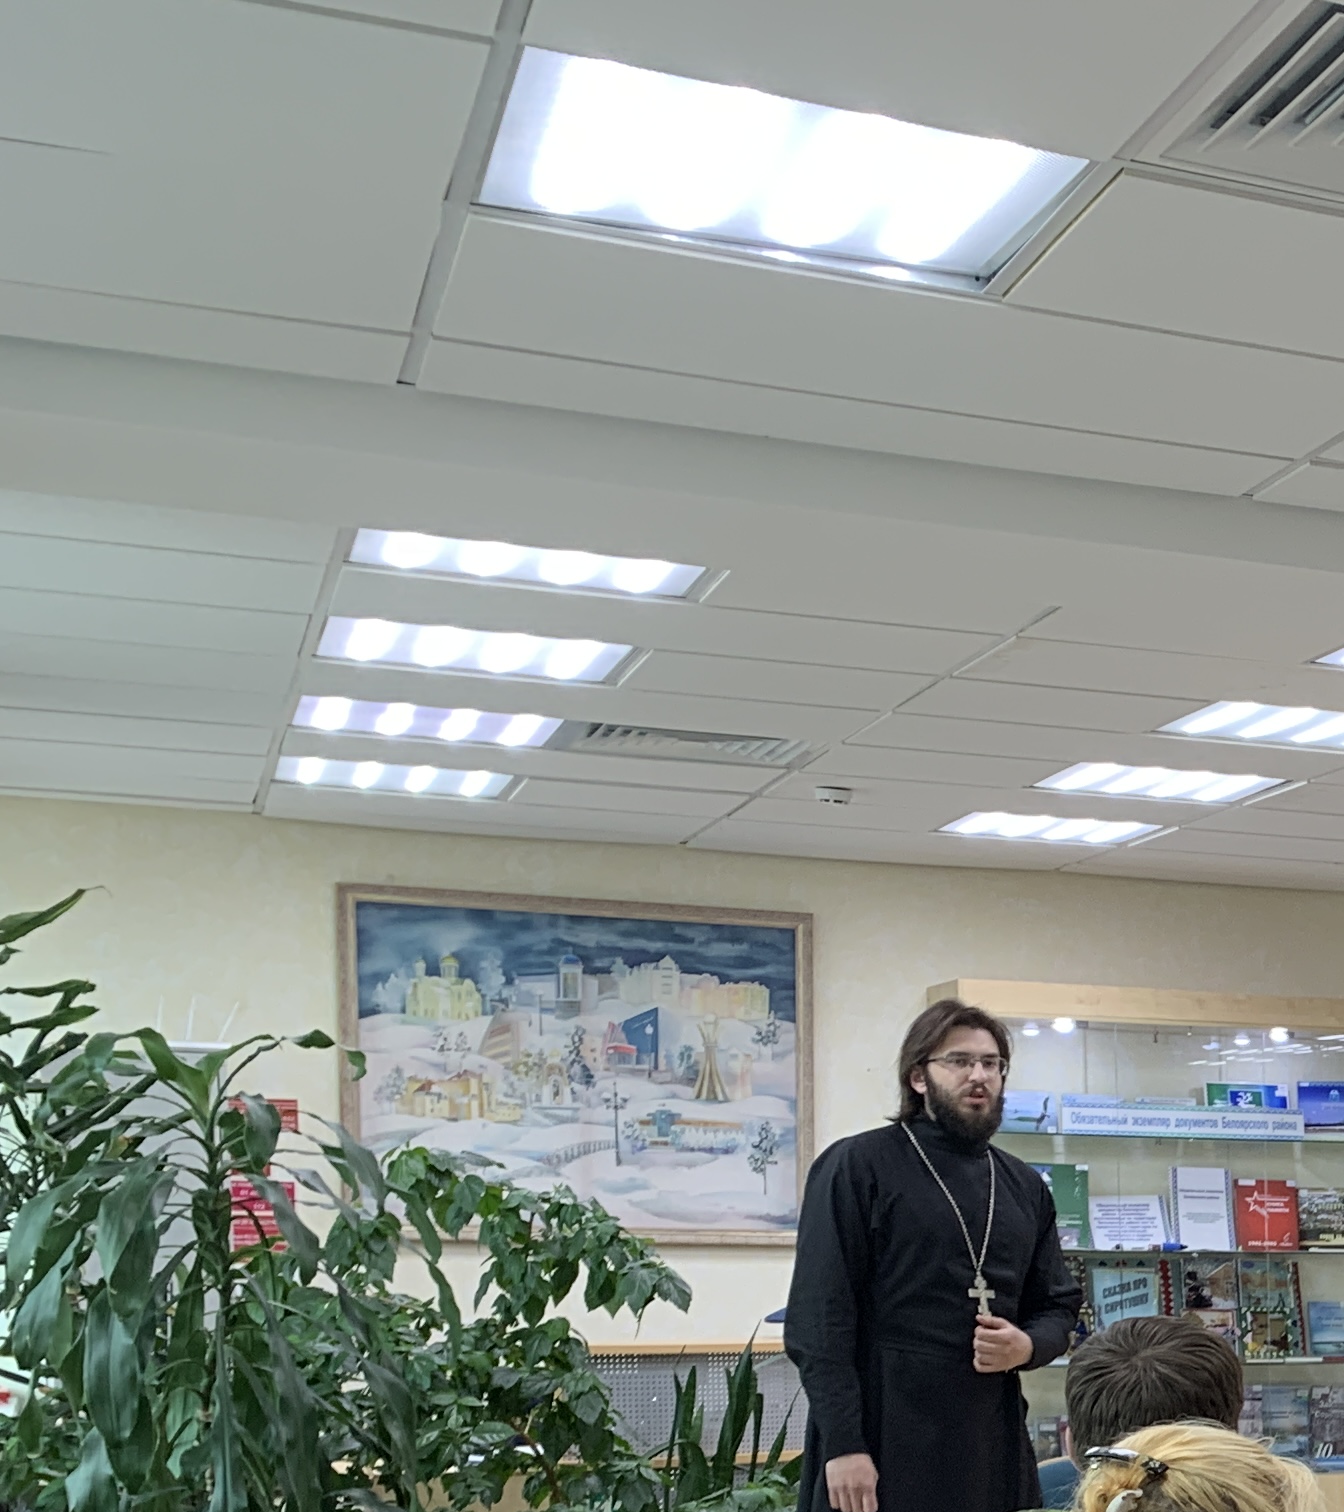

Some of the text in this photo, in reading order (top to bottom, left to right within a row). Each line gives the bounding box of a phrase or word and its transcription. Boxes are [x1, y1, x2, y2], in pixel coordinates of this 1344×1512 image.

[1070, 1111, 1298, 1132] Обязательный экземпляр документов Белоярского района
[1102, 1277, 1147, 1299] СКАЗКА ПРО
[1316, 1442, 1334, 1459] 10
